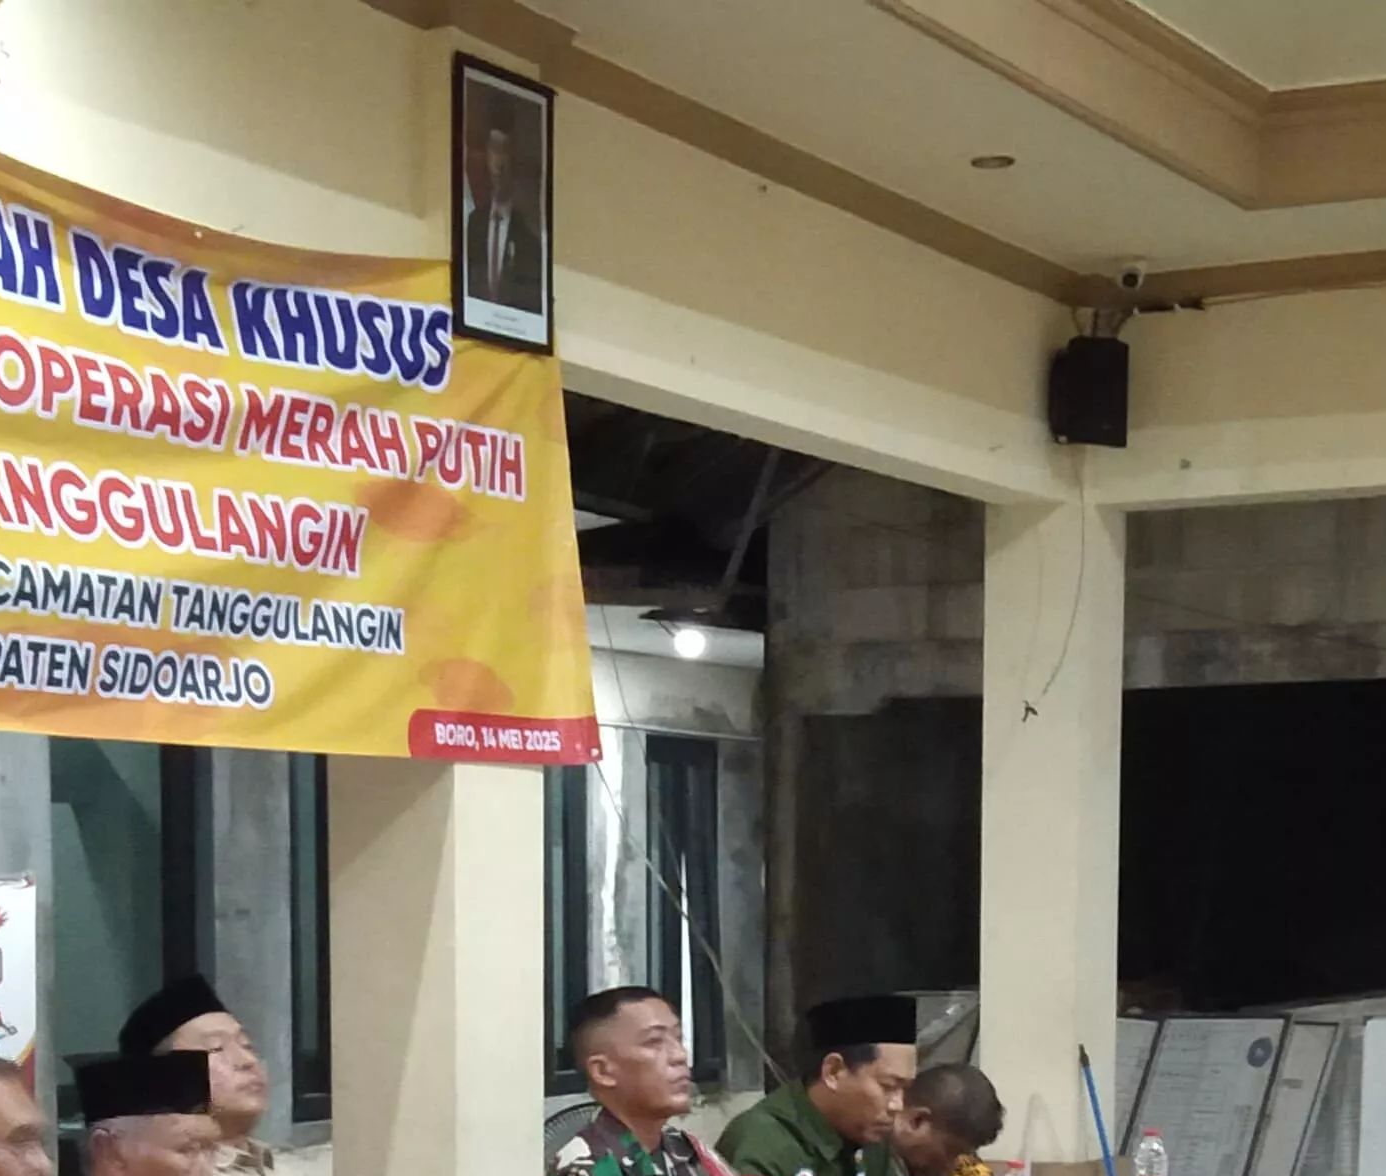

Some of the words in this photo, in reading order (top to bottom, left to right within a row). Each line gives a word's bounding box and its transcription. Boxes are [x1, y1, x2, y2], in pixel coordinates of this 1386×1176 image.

[74, 236, 222, 347] DESA
[234, 284, 451, 386] KHUSUS
[240, 391, 407, 474] MERAH
[416, 425, 523, 495] PUTIH
[173, 585, 403, 650] TANGGULANGIN
[99, 650, 271, 704] SIDOARJO
[434, 722, 479, 751] BORO,
[481, 727, 496, 748] 14
[498, 729, 523, 750] MEI
[525, 730, 561, 752] 2025
